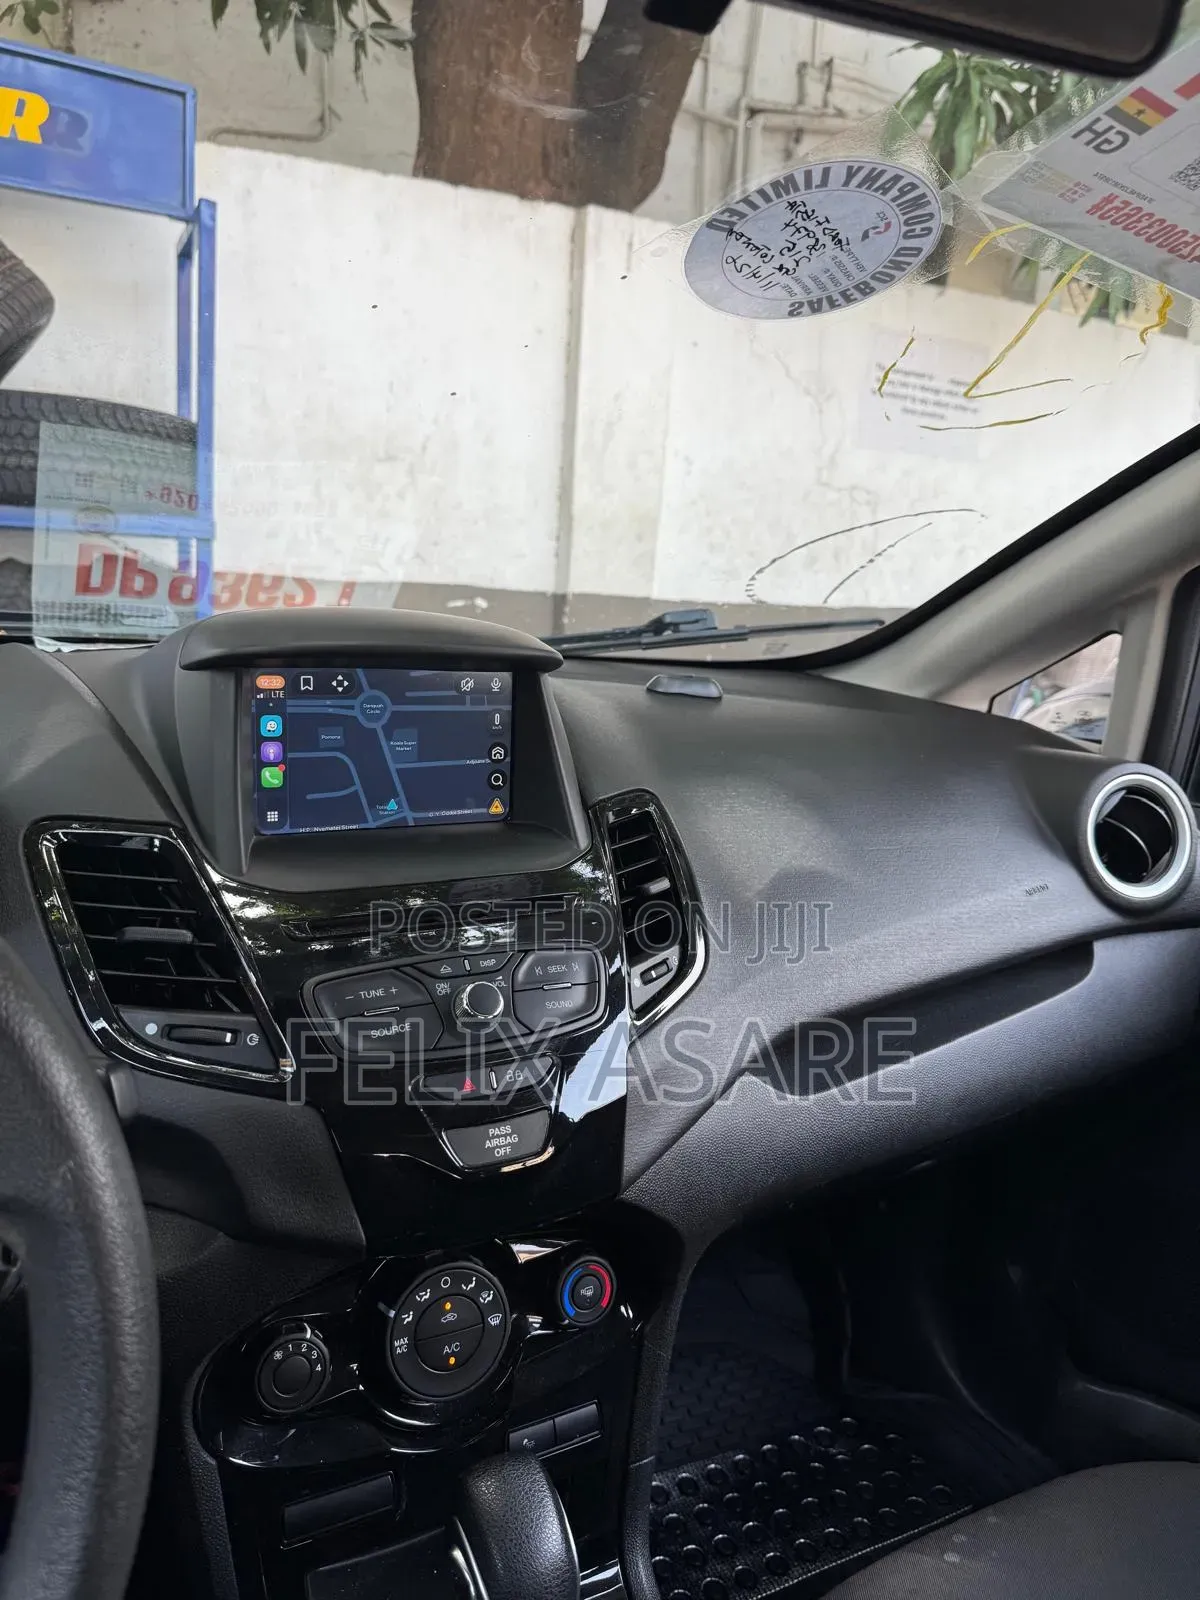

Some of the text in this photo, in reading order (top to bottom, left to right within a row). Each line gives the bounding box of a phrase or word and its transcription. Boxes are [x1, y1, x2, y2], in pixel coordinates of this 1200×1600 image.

[271, 690, 285, 698] LTE
[480, 958, 497, 968] DISP
[547, 964, 568, 974] SEEK
[492, 980, 508, 988] VOL
[359, 988, 386, 999] TUNE
[545, 1000, 574, 1010] SOUND
[370, 1022, 413, 1040] SOURCE
[488, 1125, 513, 1136] PASS
[485, 1134, 519, 1149] AIRBAG
[494, 1146, 513, 1157] OFF
[394, 1336, 409, 1348] MAX
[301, 1343, 308, 1352] 2
[396, 1344, 408, 1355] A/C
[443, 1341, 461, 1355] A/C
[311, 1350, 318, 1359] 3
[315, 1363, 322, 1372] 4
